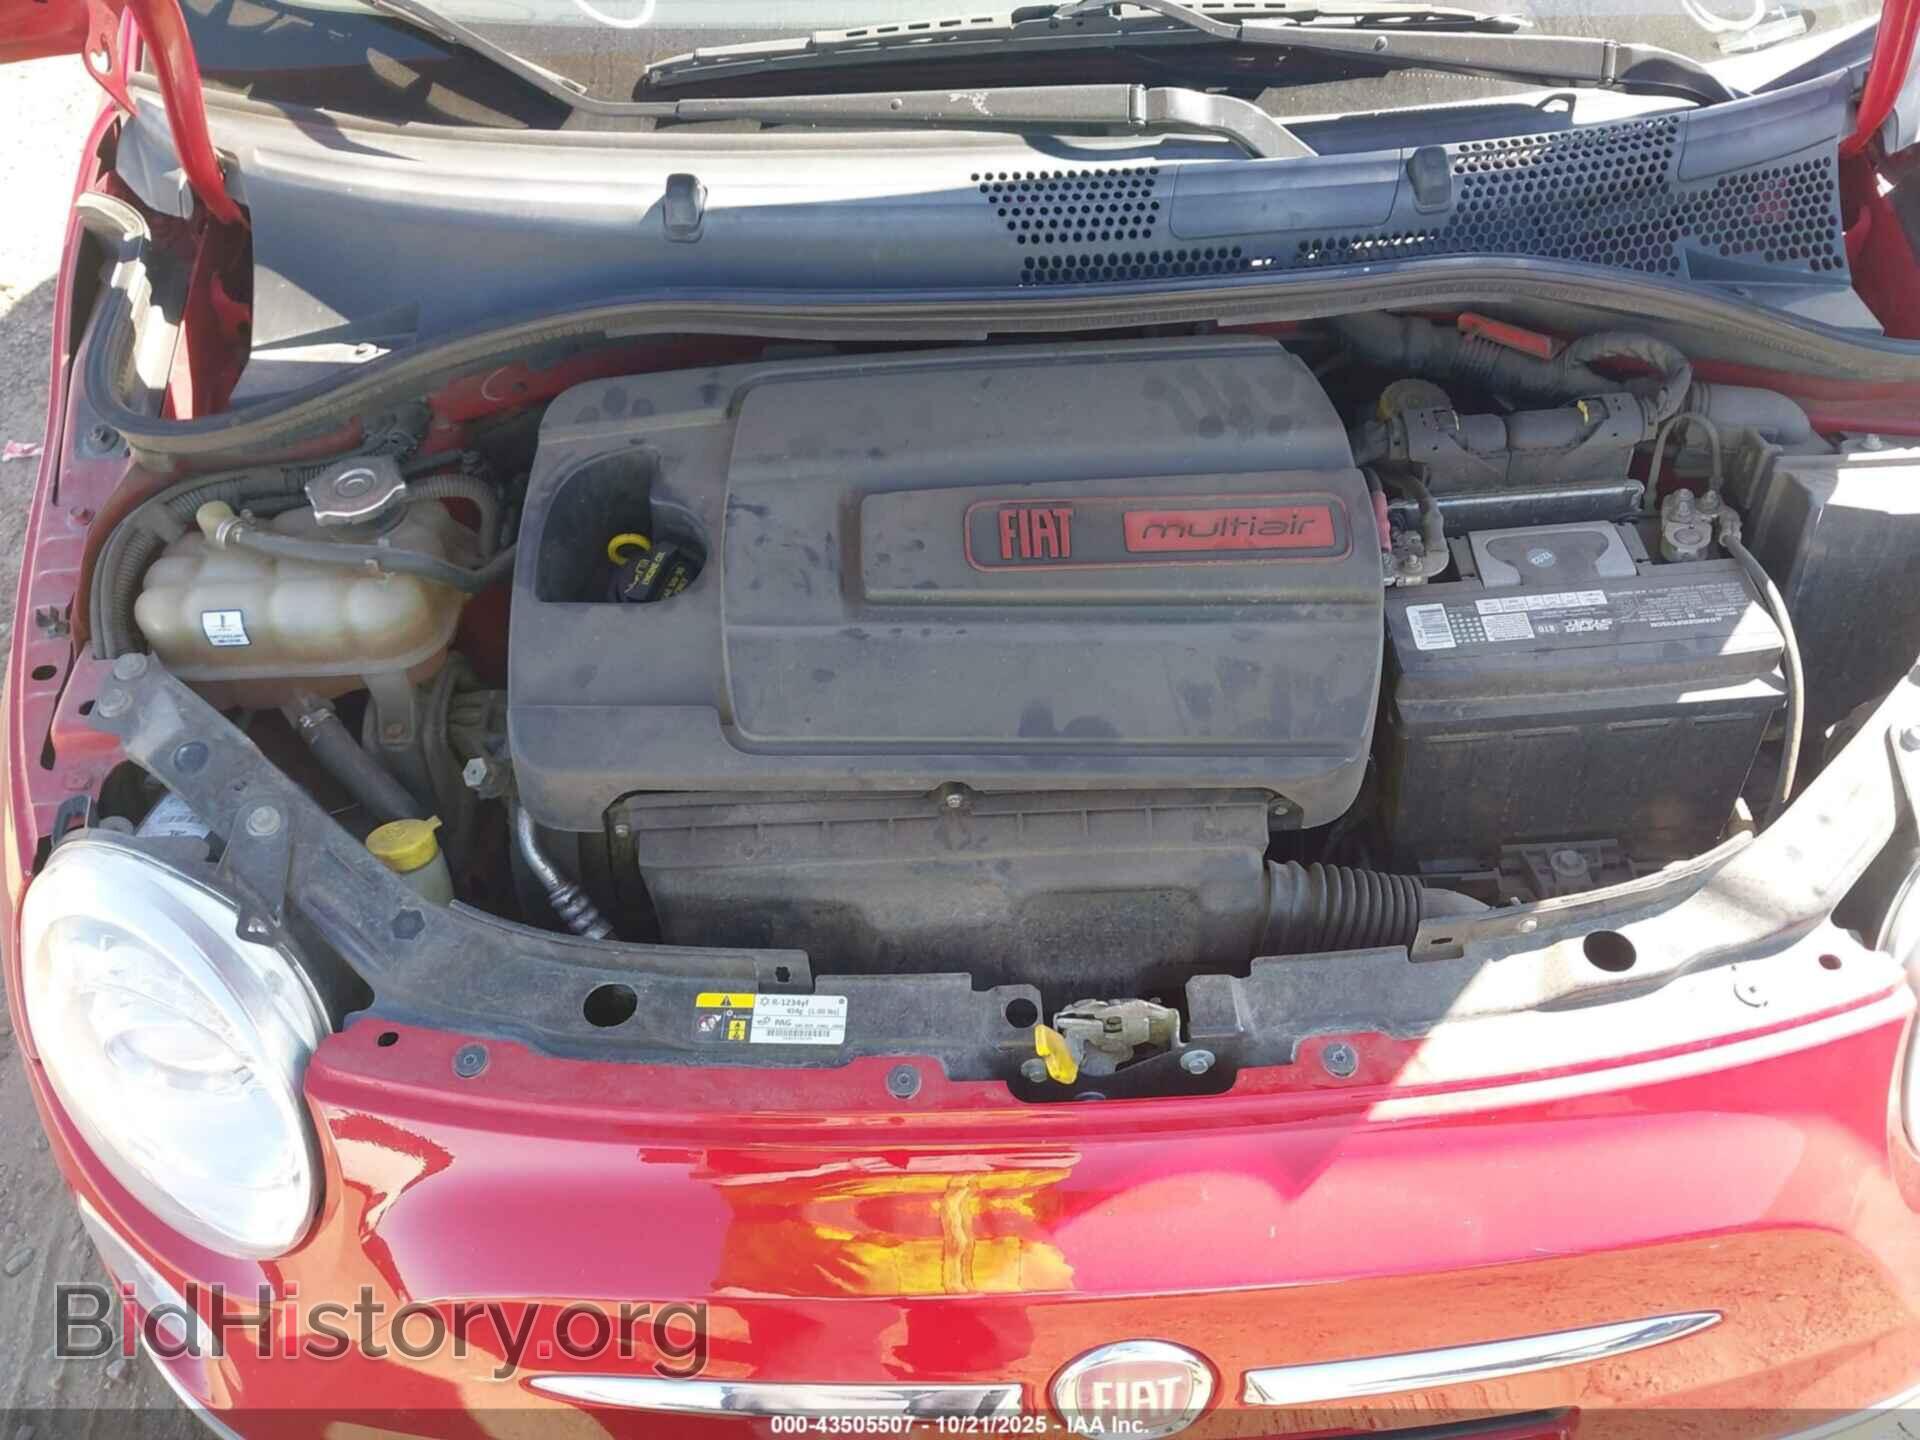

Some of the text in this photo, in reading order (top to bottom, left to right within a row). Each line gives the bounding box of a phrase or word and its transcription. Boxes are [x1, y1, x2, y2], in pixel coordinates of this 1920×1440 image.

[999, 508, 1073, 559] FIAT
[1141, 514, 1315, 541] multiair
[1090, 1375, 1184, 1418] FIAT
